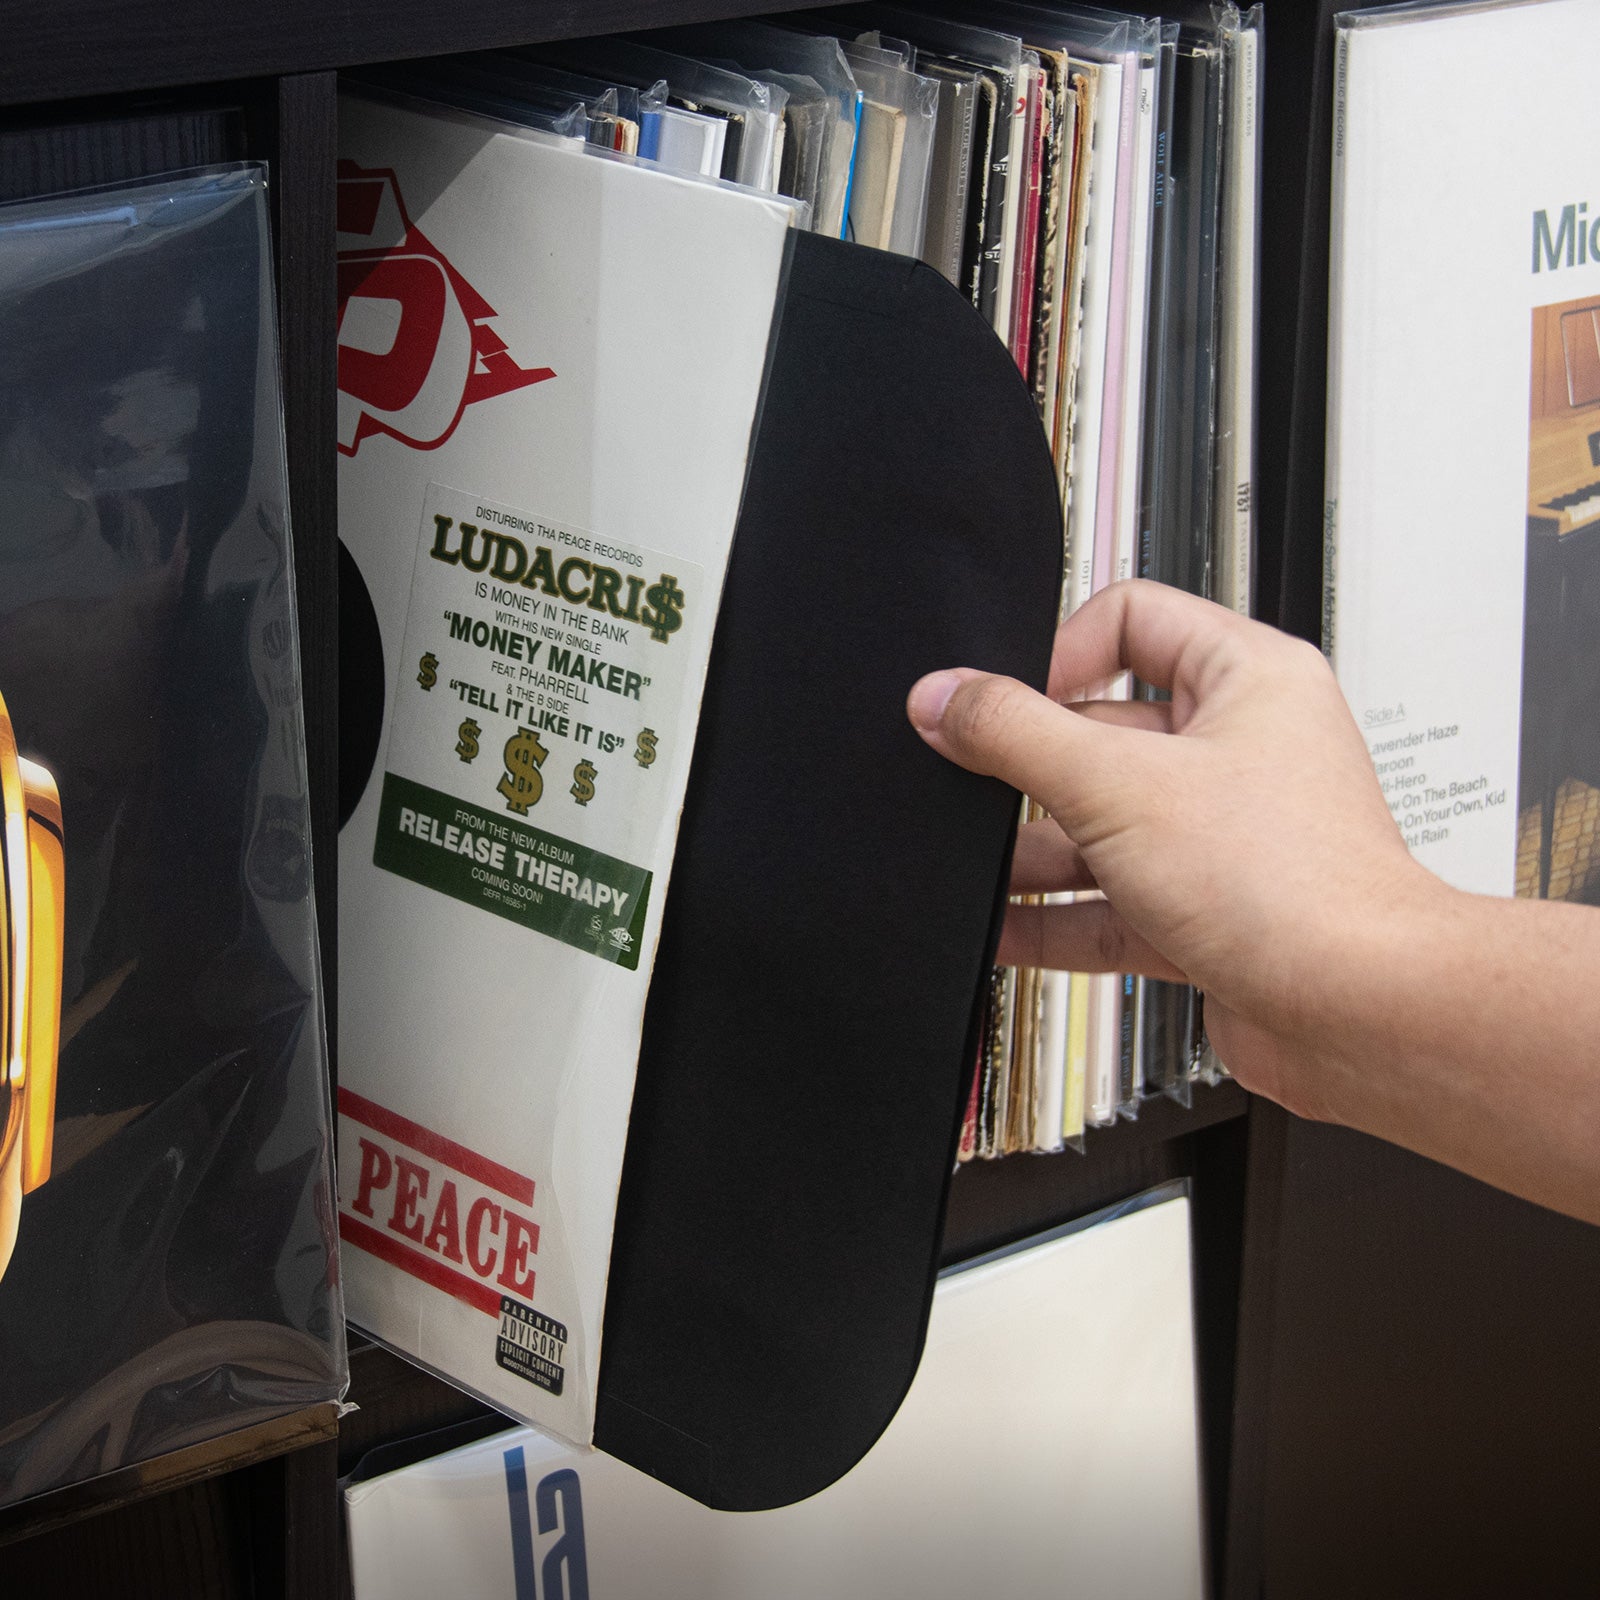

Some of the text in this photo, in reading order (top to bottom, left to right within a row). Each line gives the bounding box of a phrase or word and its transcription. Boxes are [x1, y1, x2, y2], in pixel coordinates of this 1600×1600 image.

[1155, 131, 1166, 208] WOLF ALICE
[475, 506, 644, 568] DISTURBING THA PEACE RECORDS
[1324, 498, 1338, 543] Taylor
[1323, 544, 1337, 582] Swift
[475, 581, 629, 645] IS MONEY IN THE BANK
[495, 610, 602, 656] WITH HIS NEW SINGLE
[443, 610, 651, 701] “MONEY MAKER”
[491, 660, 590, 705] FEAT. PHARRELL
[506, 683, 570, 715] & THE B SIDE
[449, 678, 625, 755] “TELL IT LIKE IT IS”
[1363, 702, 1406, 727] Side A
[1368, 723, 1459, 756] avender Haze
[1373, 755, 1415, 775] aroon
[1381, 772, 1427, 793] ti-Hero
[1401, 793, 1421, 809] On
[1422, 788, 1447, 804] The
[1449, 775, 1488, 797] Beach
[1403, 813, 1423, 828] On
[1423, 807, 1452, 823] Your
[1453, 799, 1483, 817] Own,
[1485, 789, 1507, 808] Kid
[455, 809, 574, 866] FROM THE NEW ALBUM
[1420, 826, 1449, 845] Rain
[398, 806, 629, 917] RELEASE THERAPY
[471, 867, 544, 906] COMING SOON!
[352, 1137, 541, 1300] PEACE
[501, 1314, 564, 1365] ADVISORY
[504, 1300, 564, 1340] PARENTAL
[500, 1340, 561, 1381] EXPLICIT CONTENT
